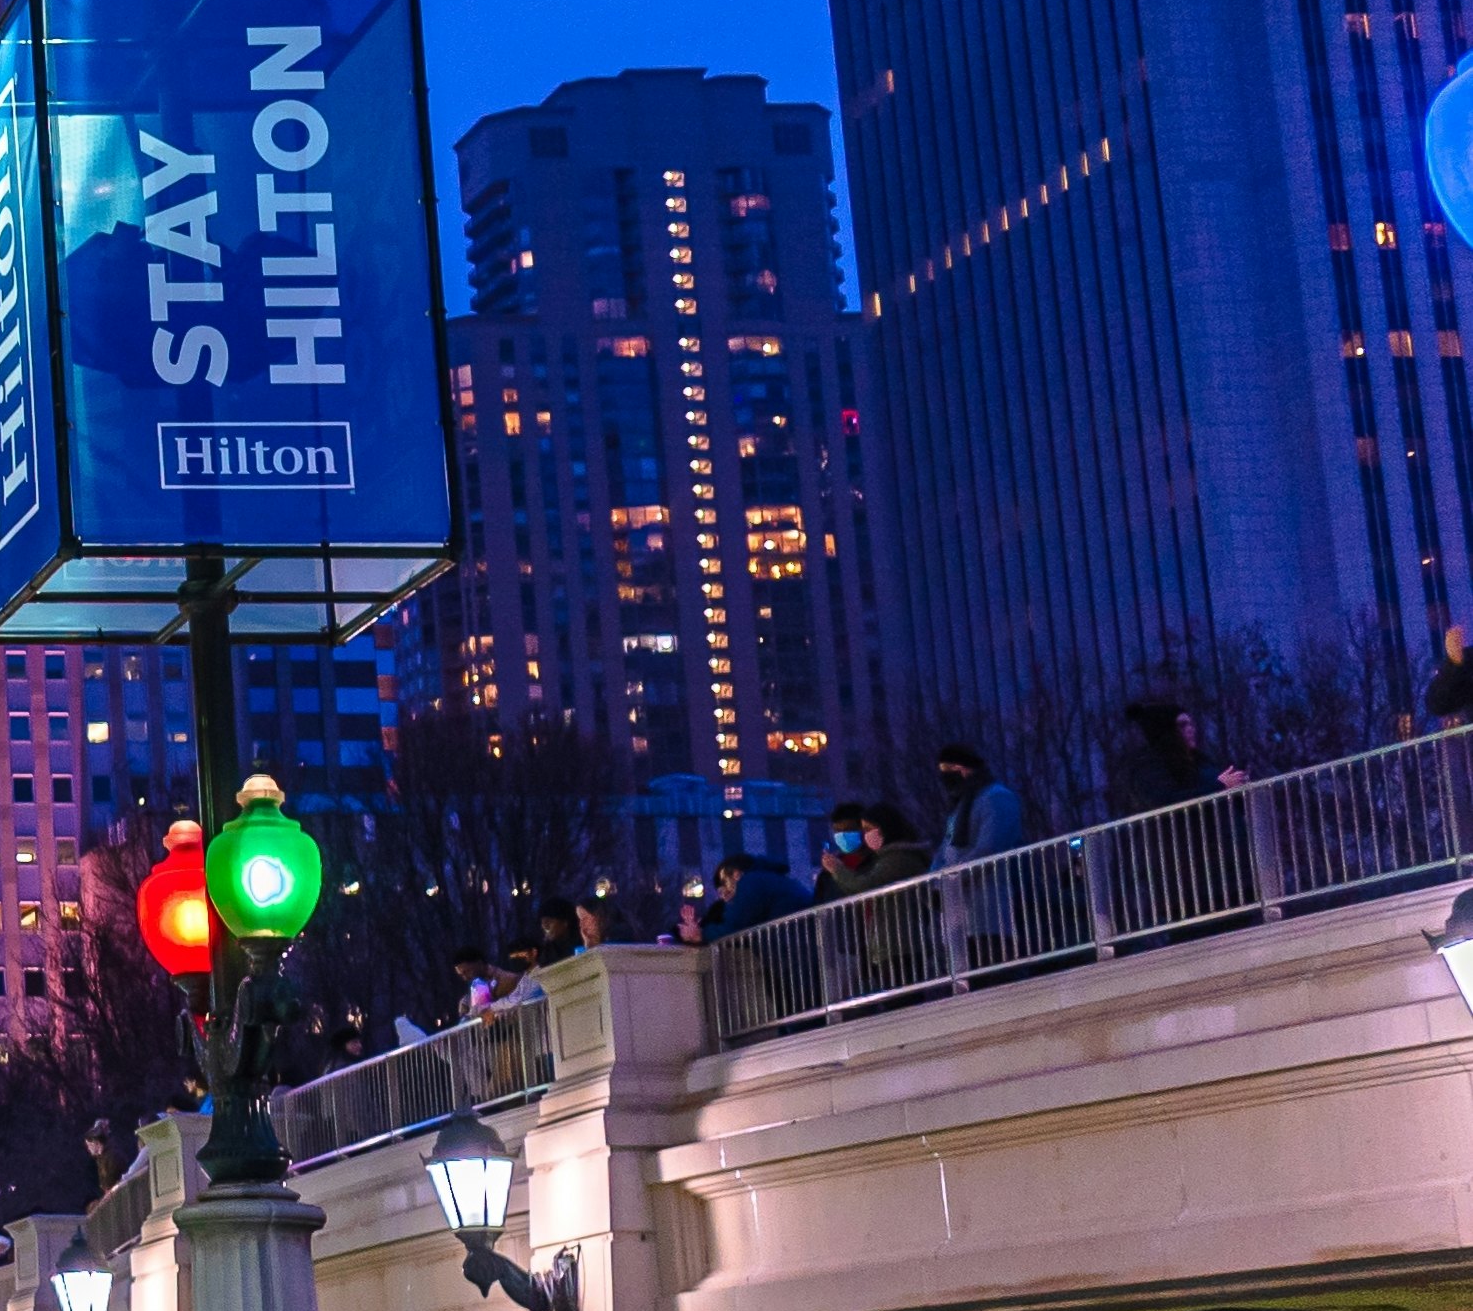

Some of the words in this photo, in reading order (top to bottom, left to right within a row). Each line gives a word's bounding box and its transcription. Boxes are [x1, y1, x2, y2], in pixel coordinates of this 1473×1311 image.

[139, 130, 229, 388] STAY
[246, 25, 346, 385] HILTON
[175, 436, 338, 477] Hilton
